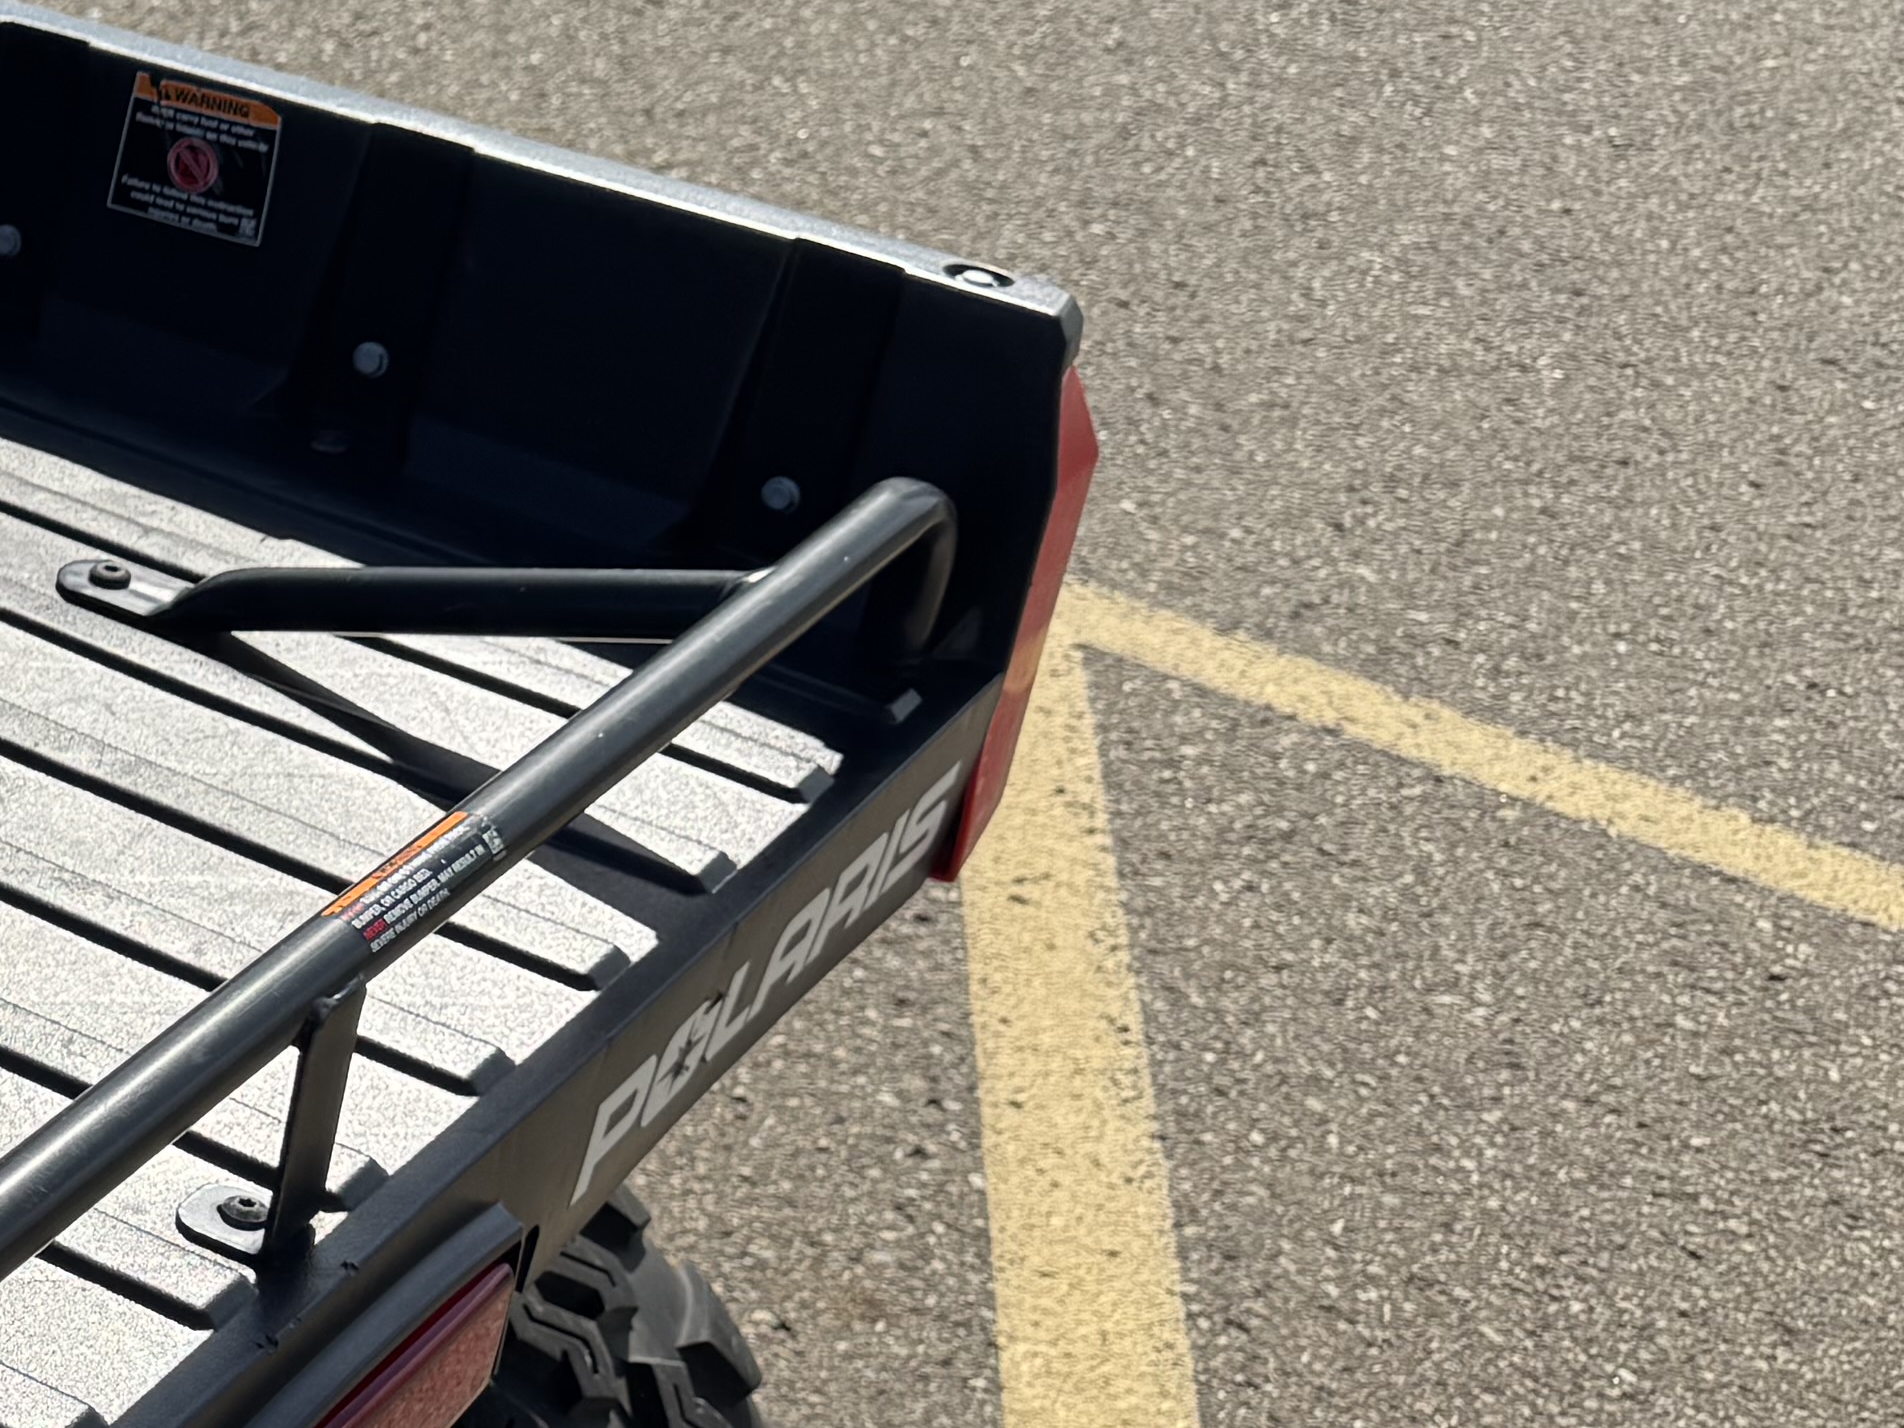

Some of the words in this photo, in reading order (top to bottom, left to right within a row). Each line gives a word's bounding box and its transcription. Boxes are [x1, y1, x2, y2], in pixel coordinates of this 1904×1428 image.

[174, 86, 250, 119] WARNING
[437, 866, 454, 882] MAY
[451, 849, 476, 872] RESULT
[474, 844, 485, 855] IN
[380, 895, 395, 906] OR
[390, 878, 416, 899] CARGO
[414, 903, 427, 916] OR
[569, 761, 961, 1206] POLARIS
